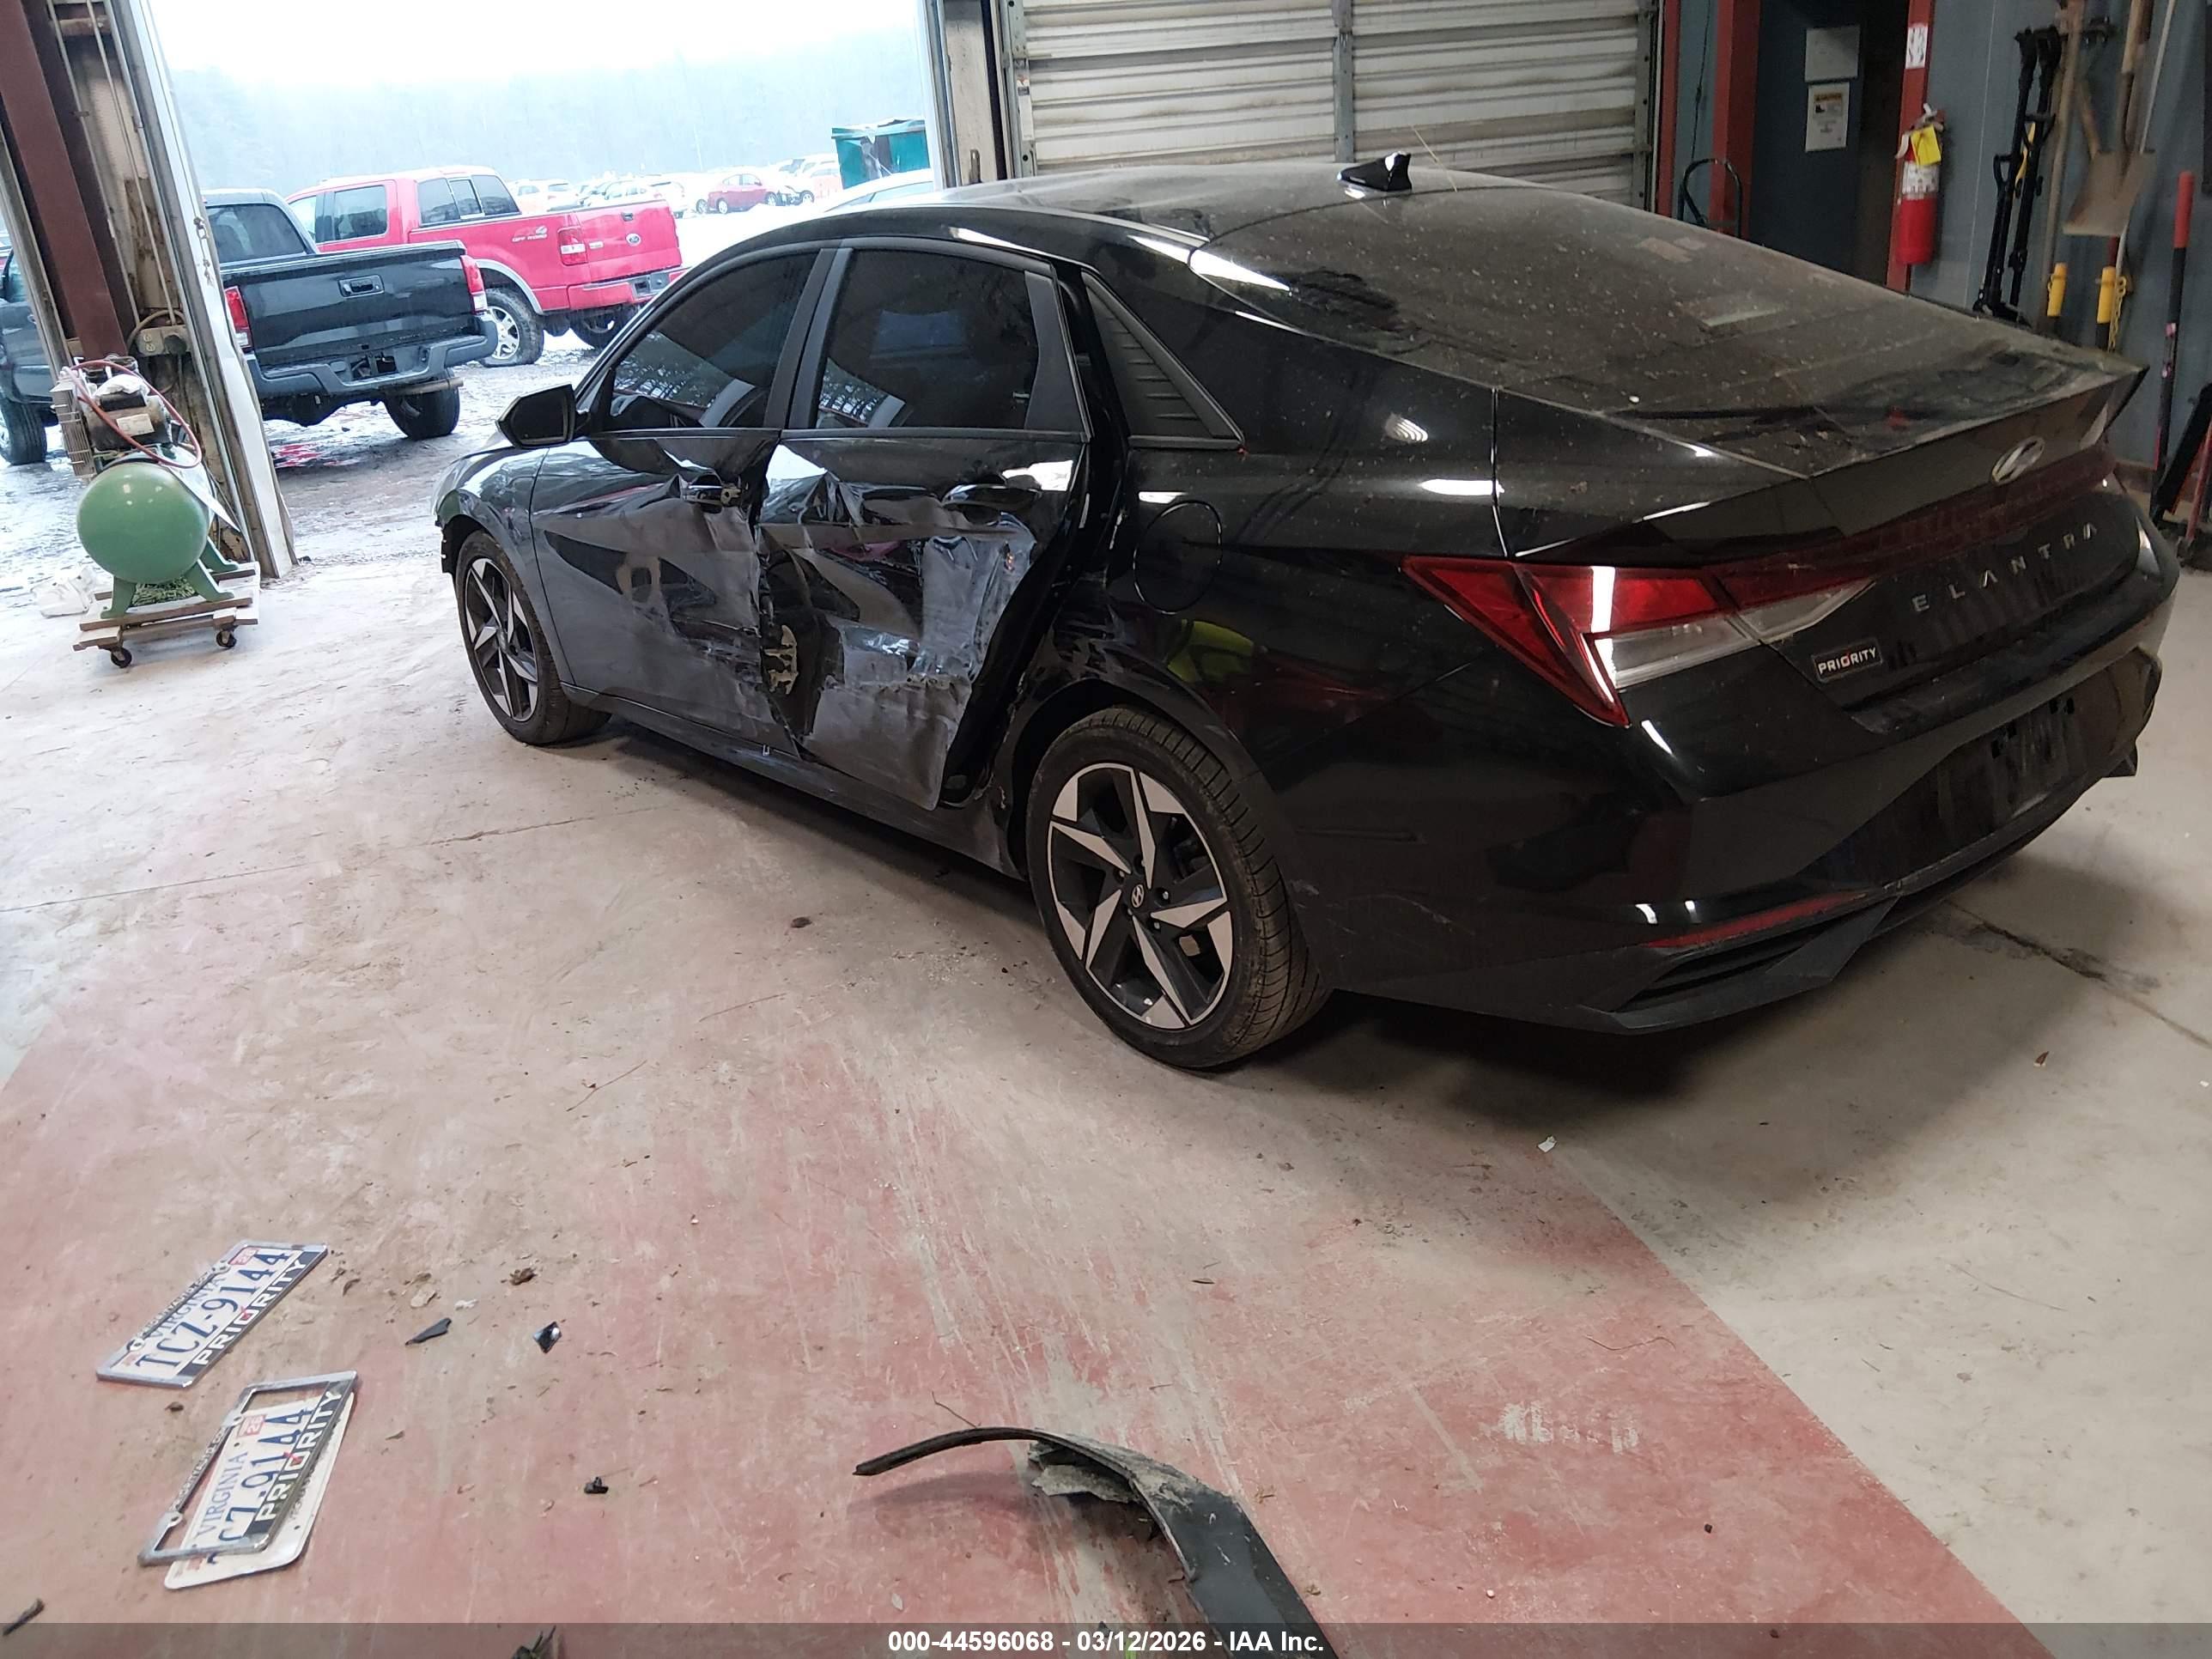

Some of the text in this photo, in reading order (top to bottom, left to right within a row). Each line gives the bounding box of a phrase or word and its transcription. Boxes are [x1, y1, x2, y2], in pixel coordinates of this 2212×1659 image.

[1911, 522, 2097, 612] ELANTRA
[1818, 647, 1876, 674] PRIORITY
[135, 1250, 290, 1368] TCZ-9144
[149, 1277, 226, 1337] VIRGINIA
[192, 1259, 307, 1365] PRIORITY
[198, 1451, 248, 1537] VIRGINIA
[254, 1390, 343, 1522] PRIORITY
